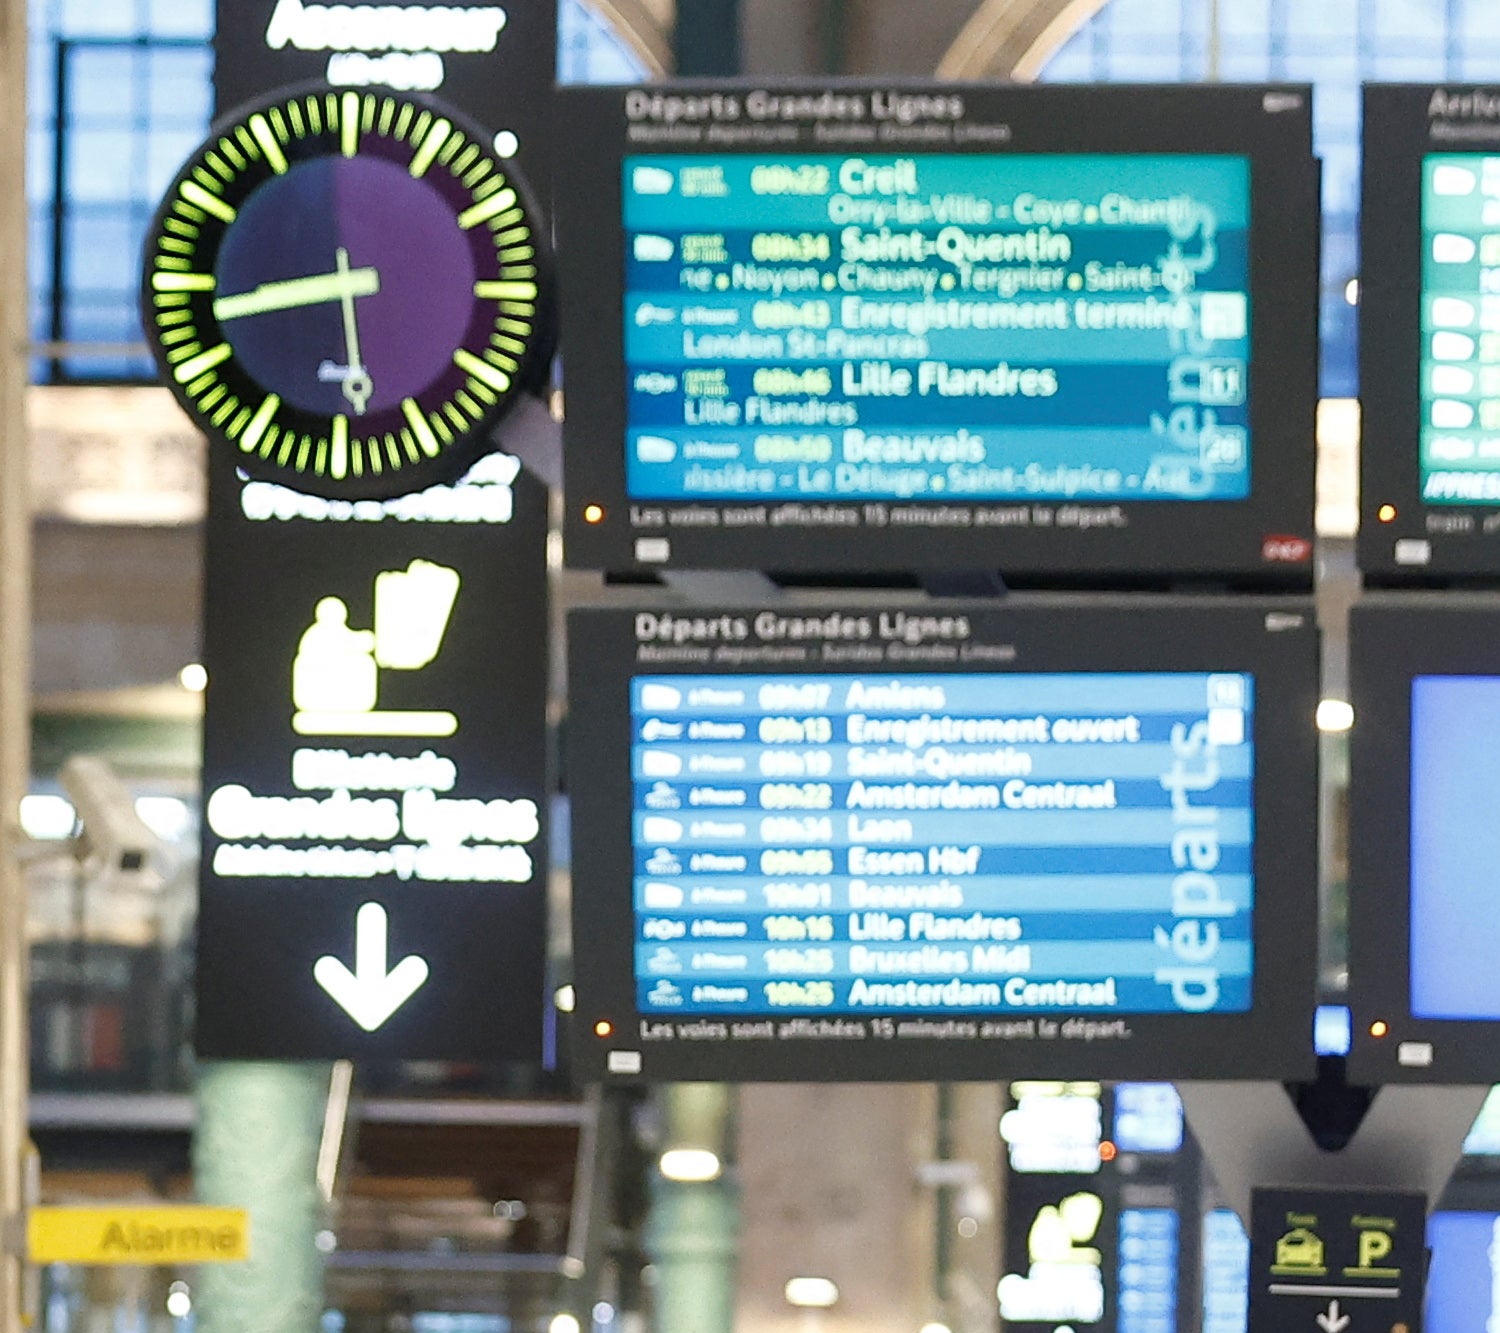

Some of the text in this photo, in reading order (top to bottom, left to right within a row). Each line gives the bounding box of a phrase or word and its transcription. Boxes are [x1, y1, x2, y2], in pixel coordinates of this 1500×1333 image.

[626, 90, 965, 124] Départs Grandes Lignes
[839, 159, 918, 195] Creil
[841, 226, 1071, 266] Saint-Quentin
[842, 296, 1070, 336] Enregistrement
[842, 361, 912, 396] Lille
[918, 361, 1057, 396] Flandres
[843, 429, 986, 464] Beauvais
[635, 611, 970, 644] Départs Grandes Lignes
[847, 713, 1049, 749] Enregistrement
[846, 780, 1000, 810] Amsterdam
[1003, 779, 1117, 809] Centraal
[848, 847, 924, 875] Essen
[1153, 720, 1237, 1012] départs
[849, 912, 906, 941] Lille
[909, 912, 1022, 941] Flandres
[848, 978, 1001, 1007] Amsterdam
[1004, 977, 1118, 1007] Centraal
[871, 1018, 895, 1038] 15
[102, 1220, 240, 1254] Alarme
[1359, 1231, 1392, 1267] P
